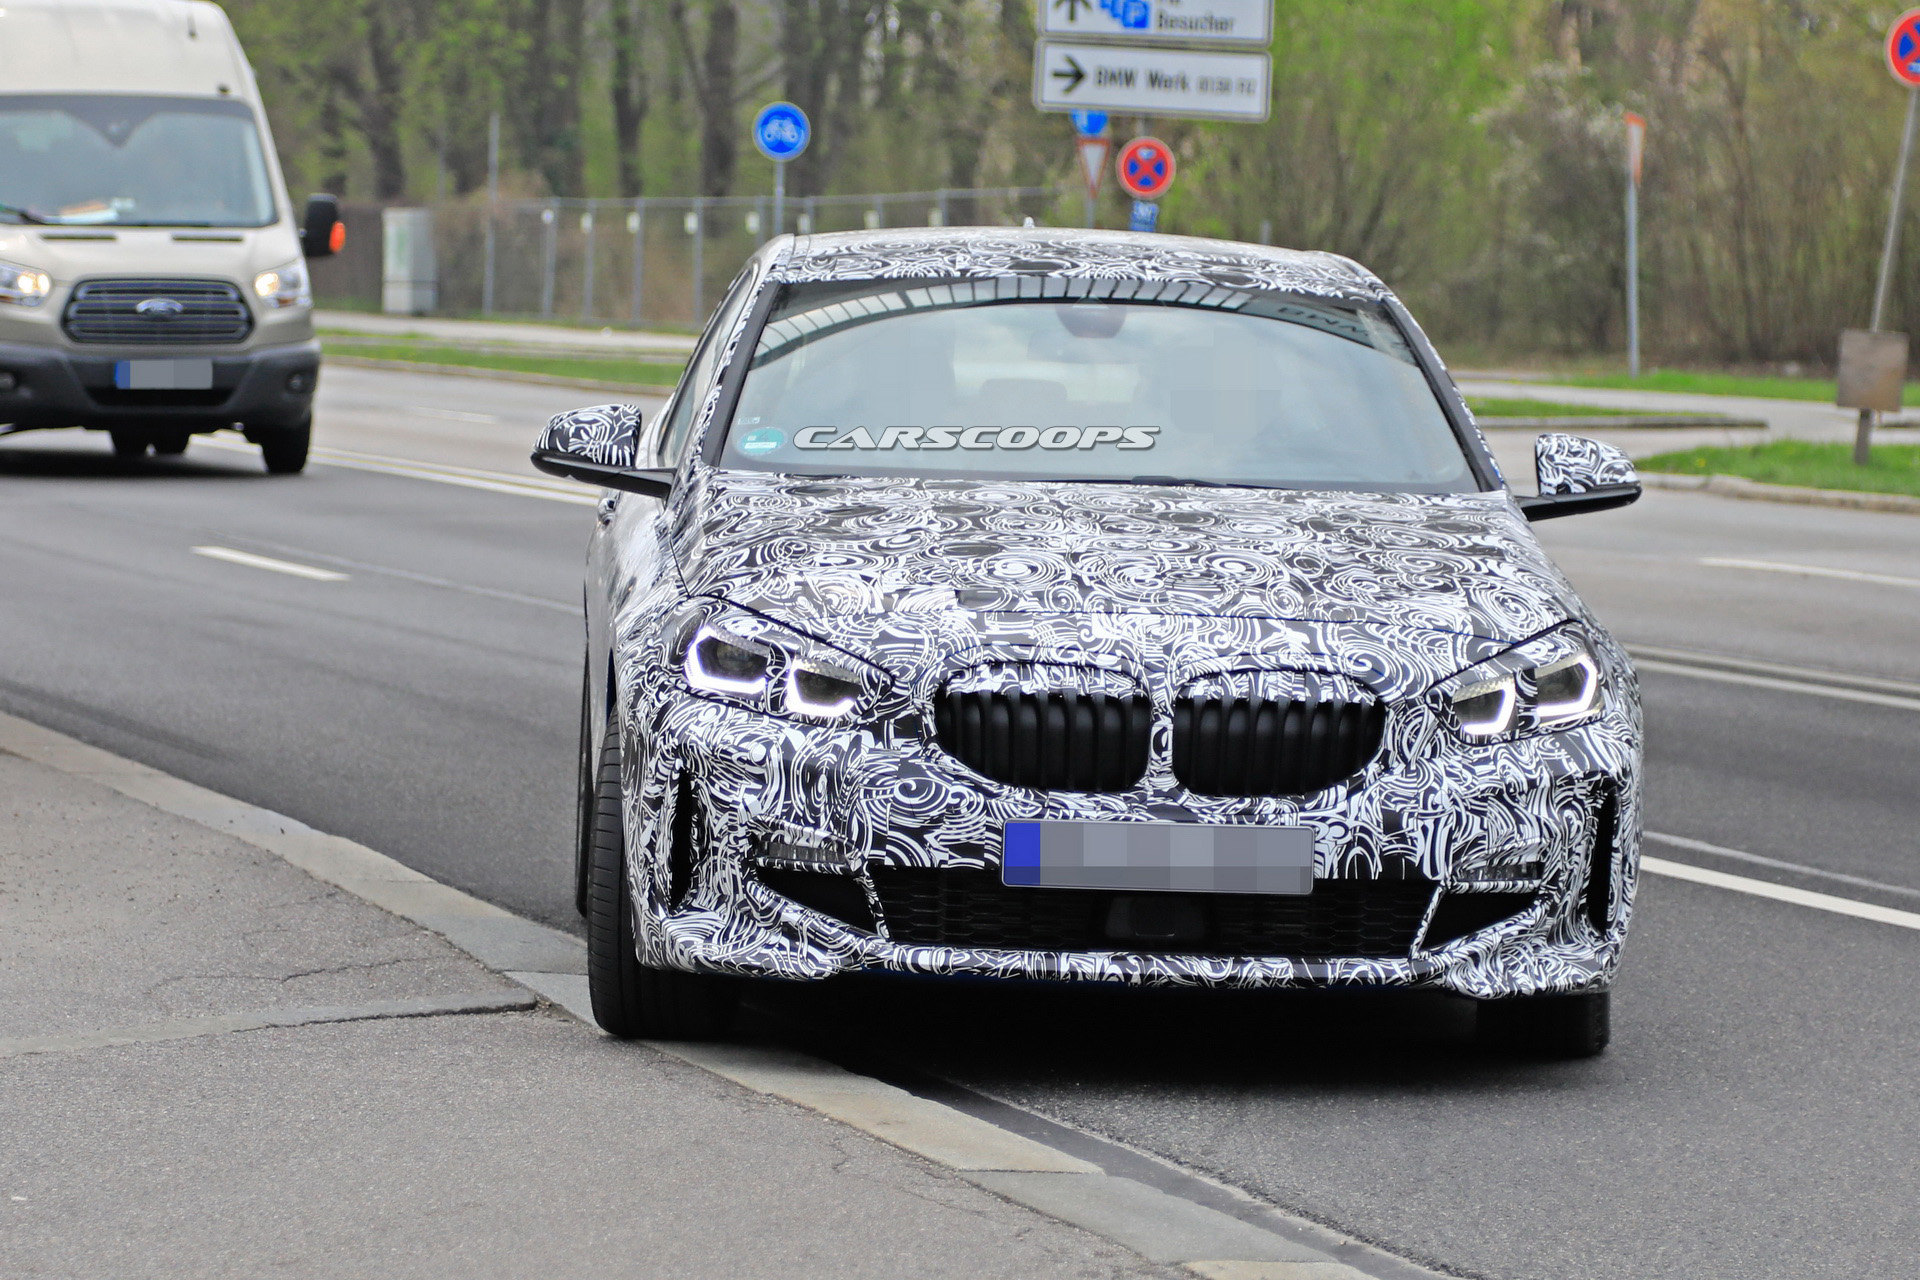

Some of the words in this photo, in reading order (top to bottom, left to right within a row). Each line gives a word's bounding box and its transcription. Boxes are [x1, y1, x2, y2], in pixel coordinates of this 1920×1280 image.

[1157, 10, 1234, 32] Besucher
[1097, 66, 1136, 88] BMW
[1147, 70, 1189, 92] Werk
